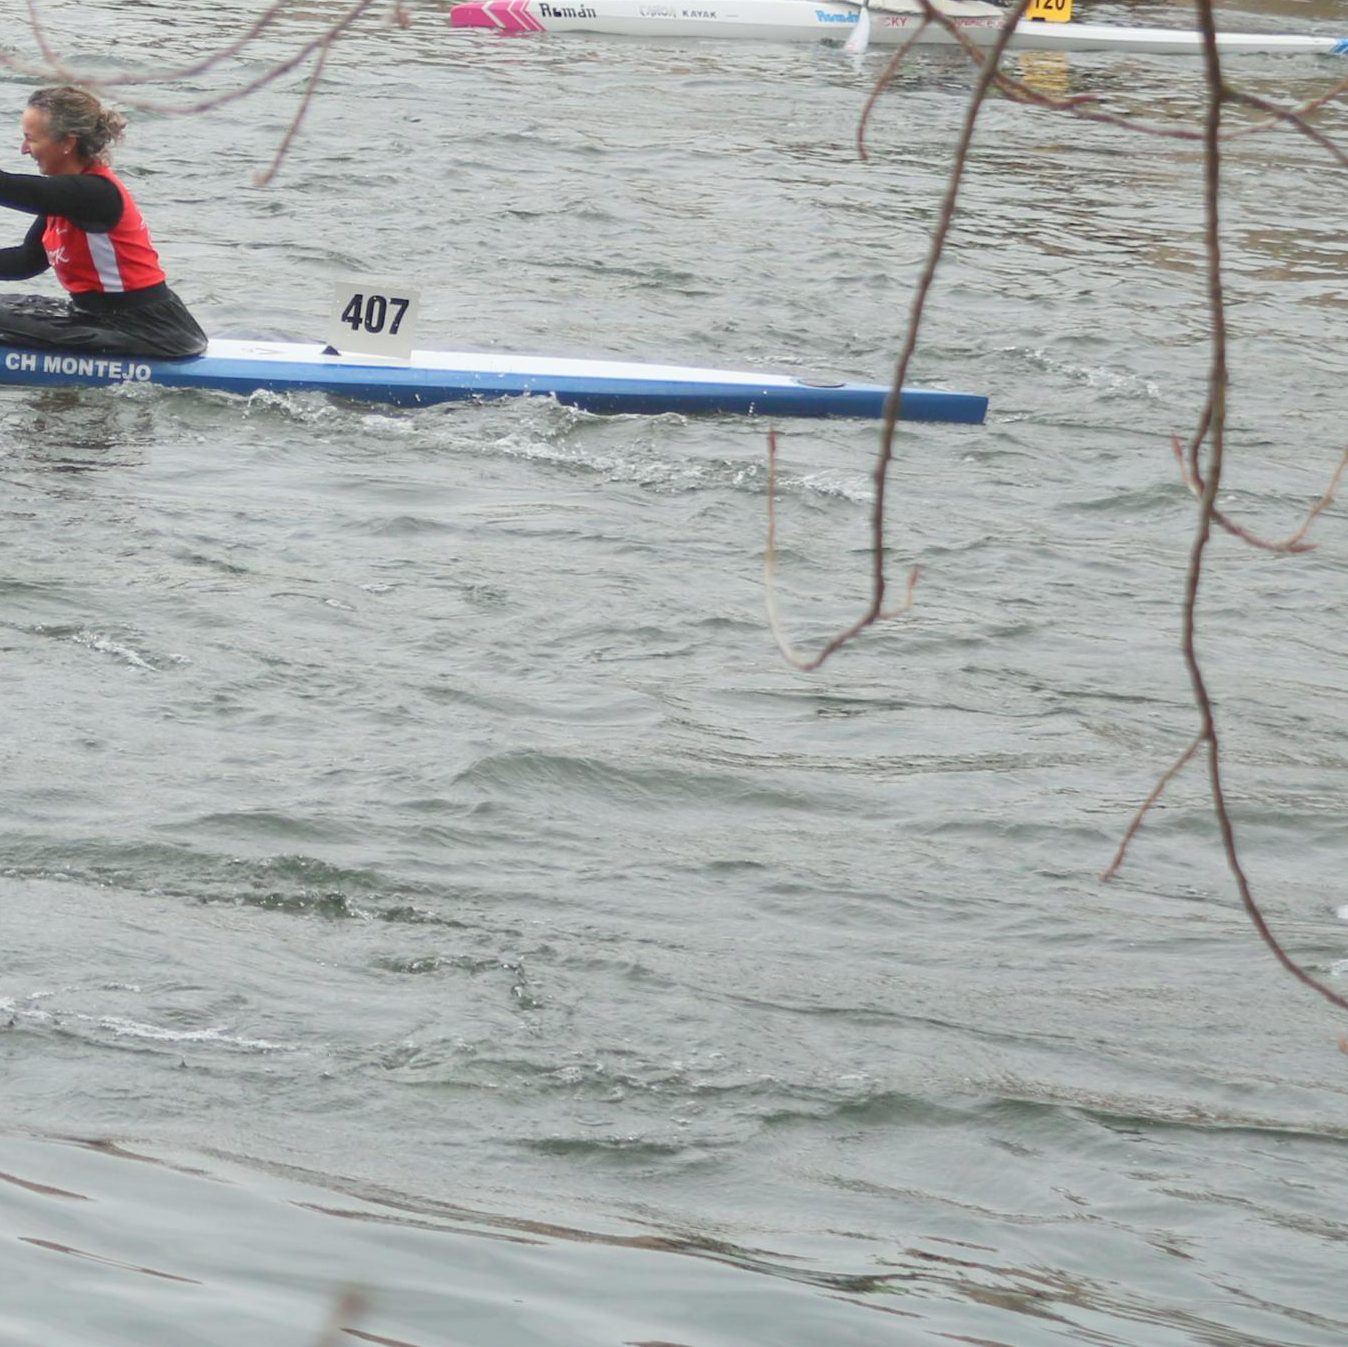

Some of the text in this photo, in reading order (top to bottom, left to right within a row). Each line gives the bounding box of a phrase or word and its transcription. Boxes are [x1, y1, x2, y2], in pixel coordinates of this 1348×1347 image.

[681, 10, 717, 20] KAYAK
[341, 293, 410, 335] 407
[5, 352, 152, 382] CH MONTEJO
